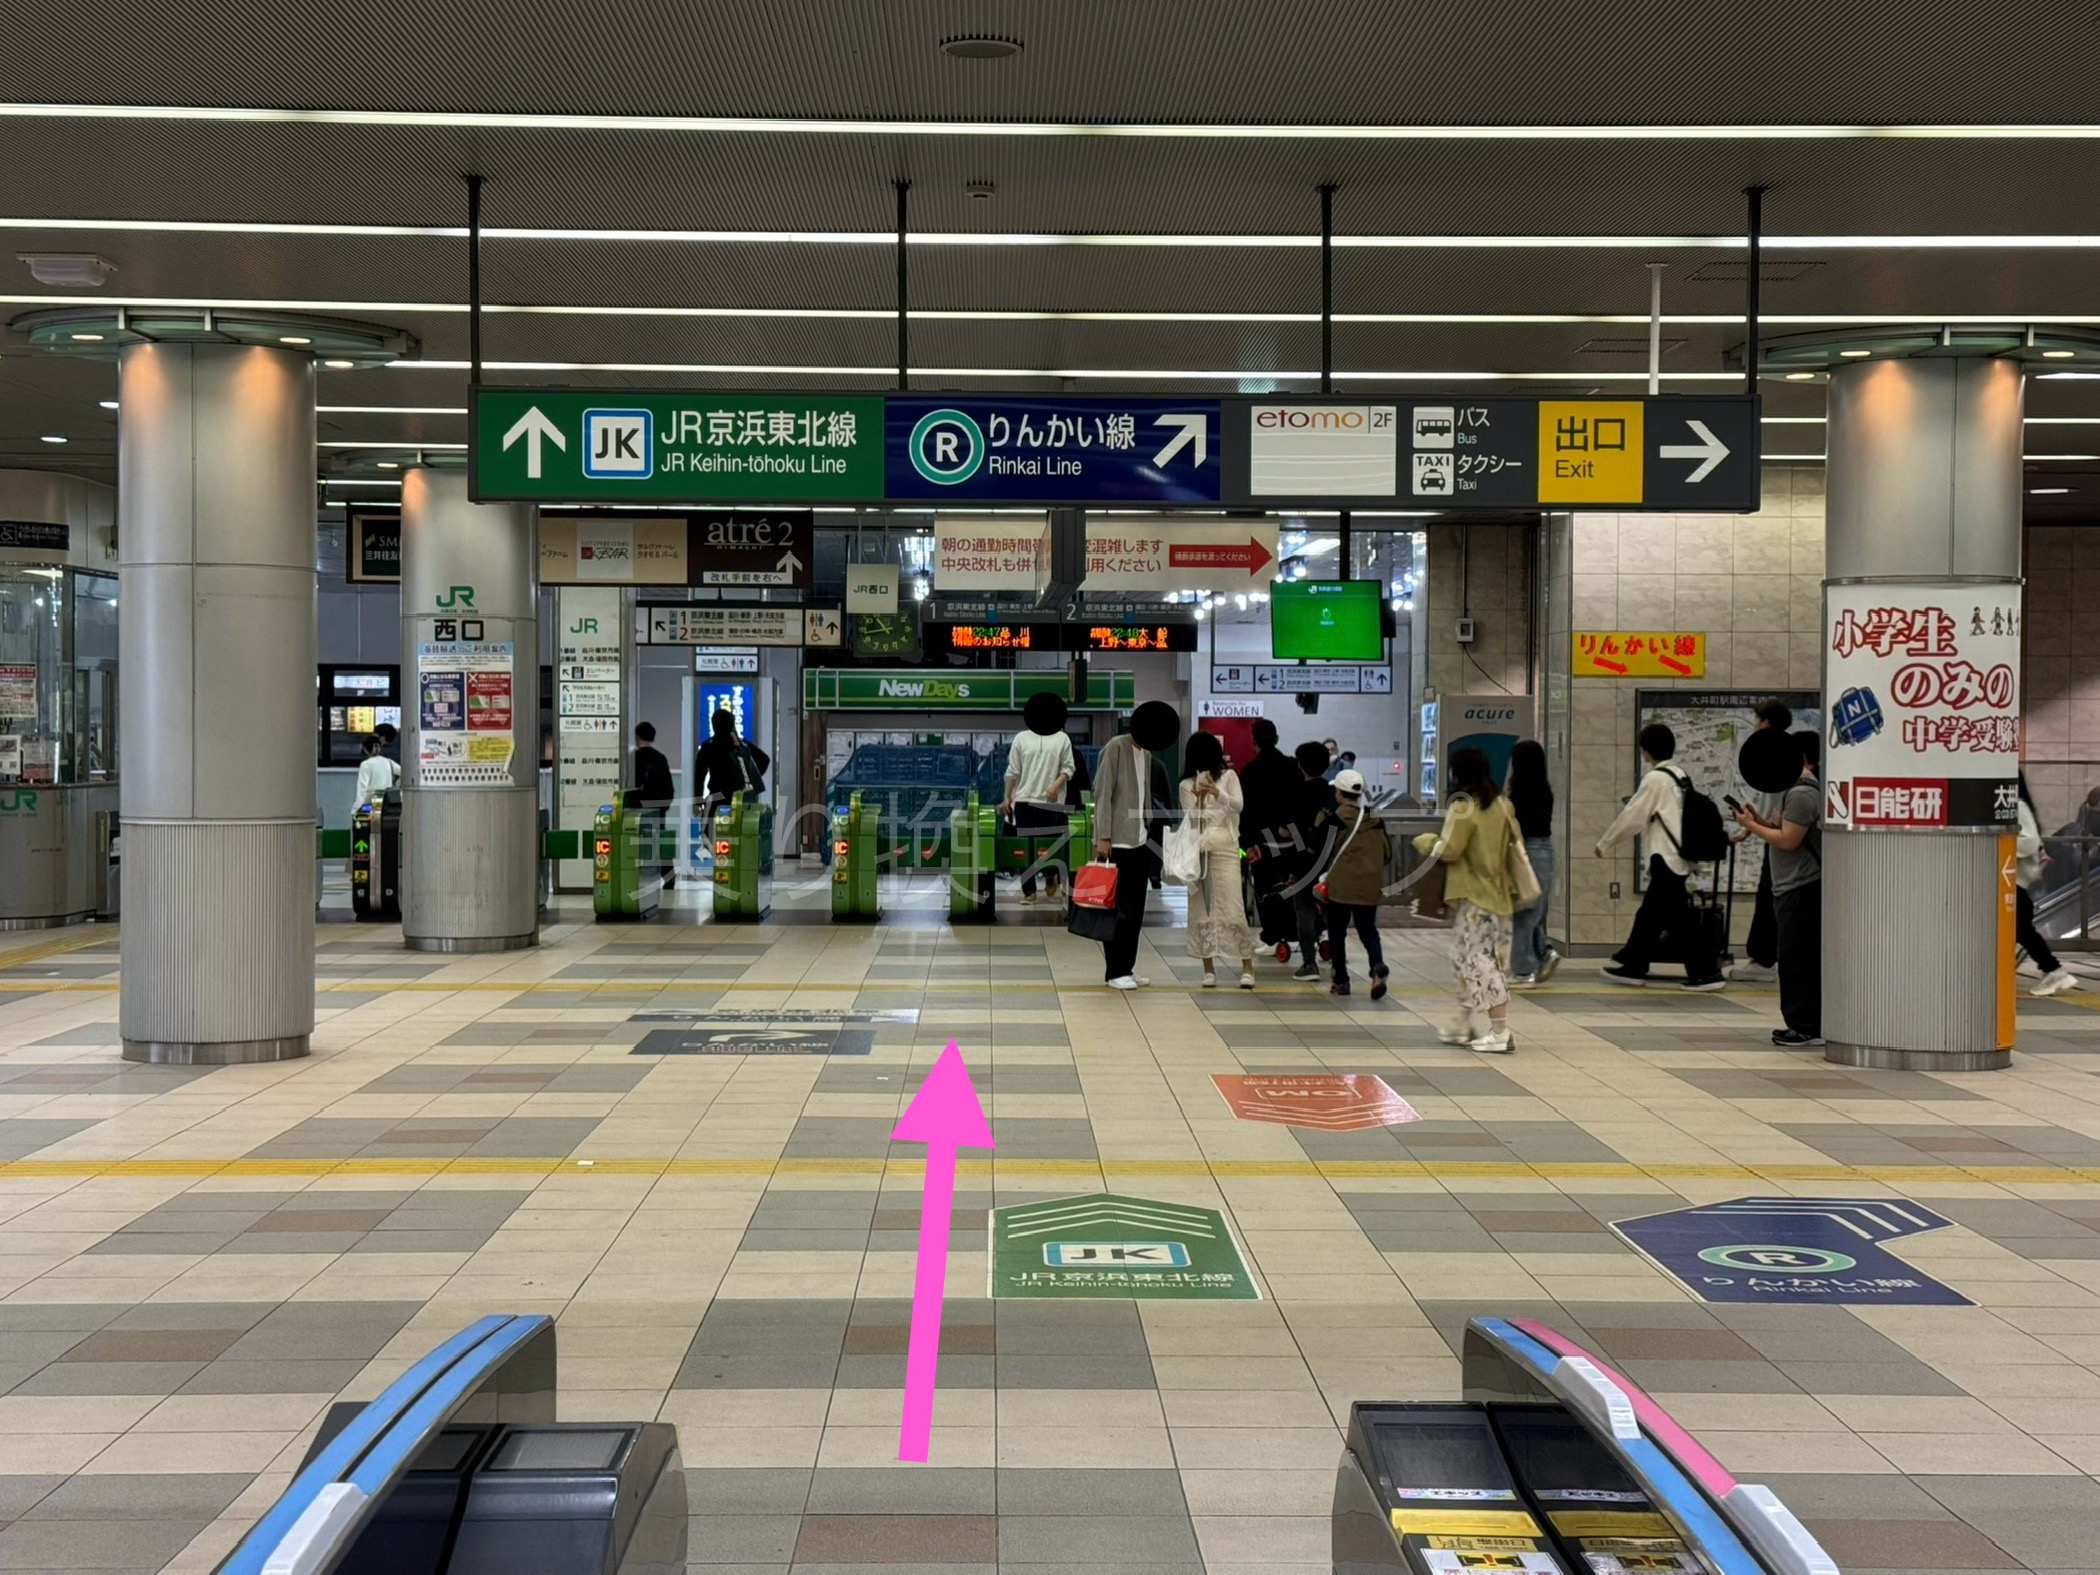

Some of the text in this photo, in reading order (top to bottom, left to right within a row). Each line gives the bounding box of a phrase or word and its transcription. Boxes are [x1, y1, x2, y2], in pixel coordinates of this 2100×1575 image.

[1256, 411, 1393, 429] etomo 2F
[1458, 406, 1491, 427] バス
[661, 410, 857, 448] JR京浜東北線
[988, 413, 1136, 451] りんかい線
[1555, 415, 1626, 452] 出口
[594, 427, 640, 459] JK
[936, 432, 959, 462] R
[1457, 432, 1477, 445] Bus
[661, 454, 685, 473] JR
[811, 454, 847, 474] Line
[989, 456, 1082, 475] Rinkai Line
[1416, 455, 1450, 467] TAXI
[1457, 454, 1522, 474] タクシー
[1555, 459, 1594, 479] Exit
[1457, 478, 1477, 491] Taxi
[707, 517, 794, 546] atré 2
[379, 536, 399, 547] SM
[942, 538, 1046, 553] 朝の通勤時間帯
[365, 550, 399, 560] 三井住友
[942, 557, 1036, 572] 中央改札も併
[436, 586, 475, 607] JR
[853, 585, 889, 595] JR西口
[930, 602, 936, 619] 1
[1066, 603, 1076, 620] 2
[433, 619, 485, 642] 西口
[570, 618, 598, 634] JR
[679, 627, 688, 640] 2
[1833, 607, 1958, 658] 小学生
[1579, 634, 1697, 656] りんかい線
[878, 680, 970, 699] NewDays
[1891, 660, 2015, 709] のみの
[1213, 706, 1259, 716] WOMEN
[1465, 708, 1515, 720] acure
[1846, 700, 1861, 717] N
[1903, 716, 2020, 752] 中学受験
[1855, 786, 1944, 820] 日能研
[1994, 784, 2019, 808] 大井
[596, 814, 610, 825] IC
[596, 841, 610, 853] IC
[716, 840, 729, 854] IC
[834, 840, 848, 854] IC
[1070, 1248, 1163, 1260] JK
[1749, 1252, 1807, 1264] R
[1010, 1272, 1235, 1282] JR京浜東北線
[1703, 1276, 1922, 1288] りんかい線
